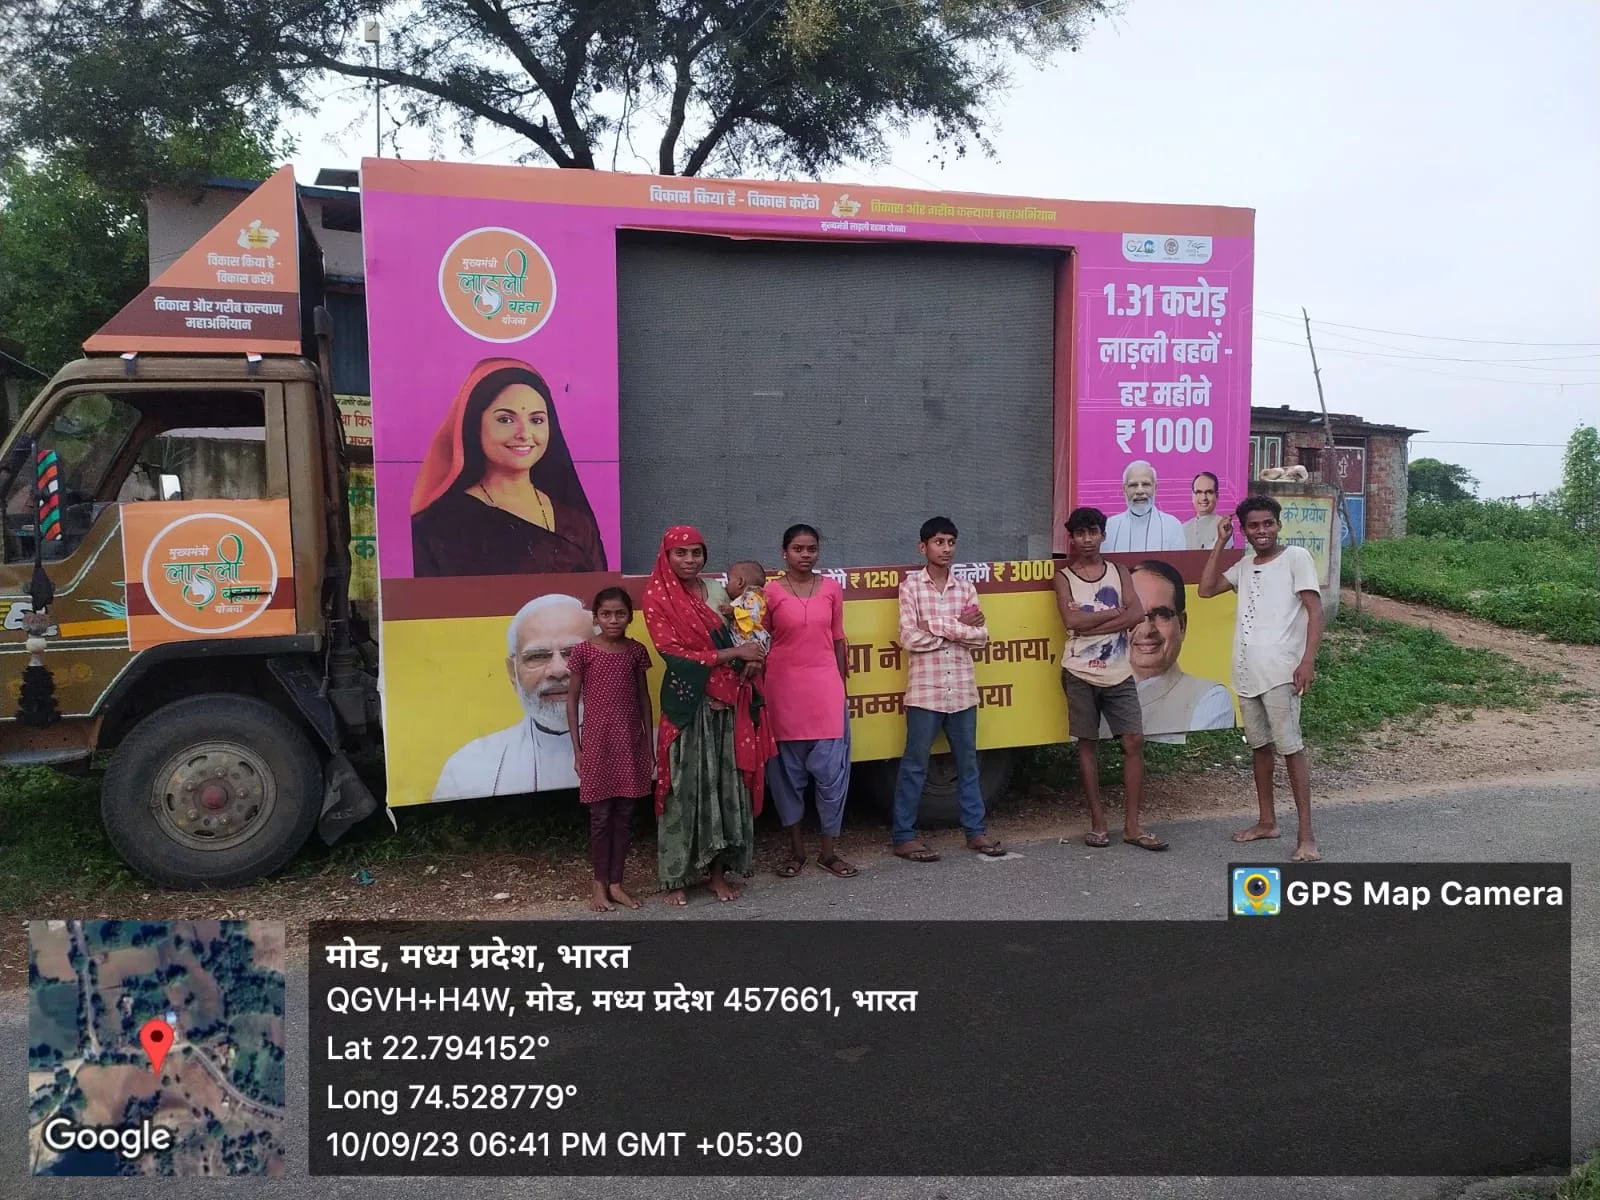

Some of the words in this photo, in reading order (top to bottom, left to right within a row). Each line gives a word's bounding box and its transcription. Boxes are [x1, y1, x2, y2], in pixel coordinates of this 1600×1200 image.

[649, 185, 691, 204] विकास
[694, 187, 725, 206] किया
[747, 190, 787, 208] विकास
[789, 194, 820, 210] करेंगे
[871, 199, 904, 214] विकास
[906, 201, 926, 216] और
[207, 252, 240, 267] विकास
[242, 254, 266, 268] किया
[216, 270, 249, 283] विकास
[250, 271, 275, 285] करेंगे
[154, 296, 191, 312] विकास
[192, 297, 214, 313] और
[215, 298, 242, 314] गरीब
[243, 302, 284, 315] कल्याण
[508, 299, 542, 314] बहना
[1103, 282, 1154, 317] 1.31
[1159, 276, 1229, 326] करोड़
[184, 315, 252, 330] महाअभियान
[502, 314, 527, 326] योजना
[1097, 330, 1169, 370] लाड़ली
[1171, 331, 1223, 364] बहनें
[1118, 381, 1149, 407] हर
[1151, 374, 1212, 407] महीने
[1141, 417, 1213, 453] 1000
[168, 545, 210, 559] मुख्यमंत्री
[863, 571, 899, 589] 1250
[1010, 560, 1055, 582] 3000
[214, 604, 244, 614] योजना
